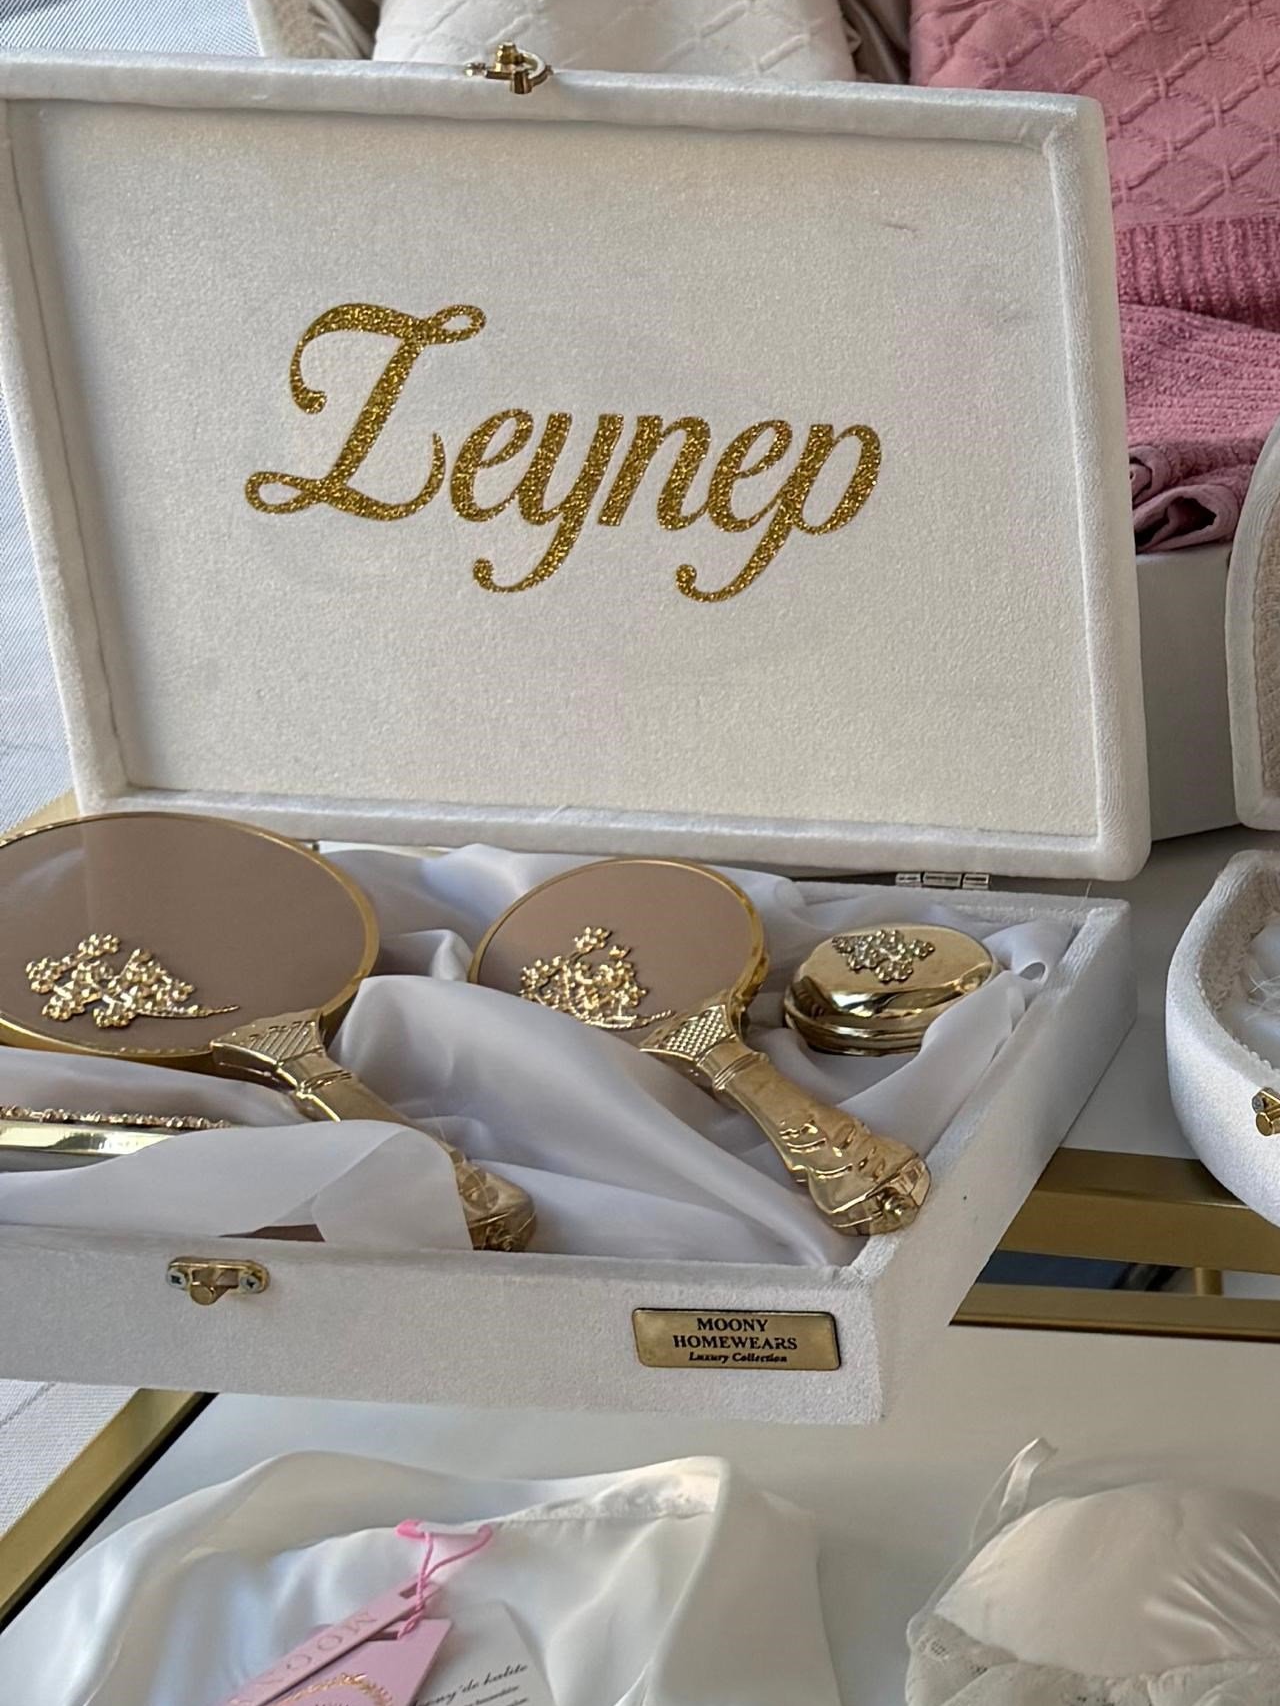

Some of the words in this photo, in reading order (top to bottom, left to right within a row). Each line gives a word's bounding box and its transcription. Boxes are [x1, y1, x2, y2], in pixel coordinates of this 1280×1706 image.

[696, 1317, 769, 1333] MOONY
[673, 1335, 798, 1350] HOMEWEARS
[688, 1351, 729, 1364] Luxury
[732, 1352, 788, 1363] Collection
